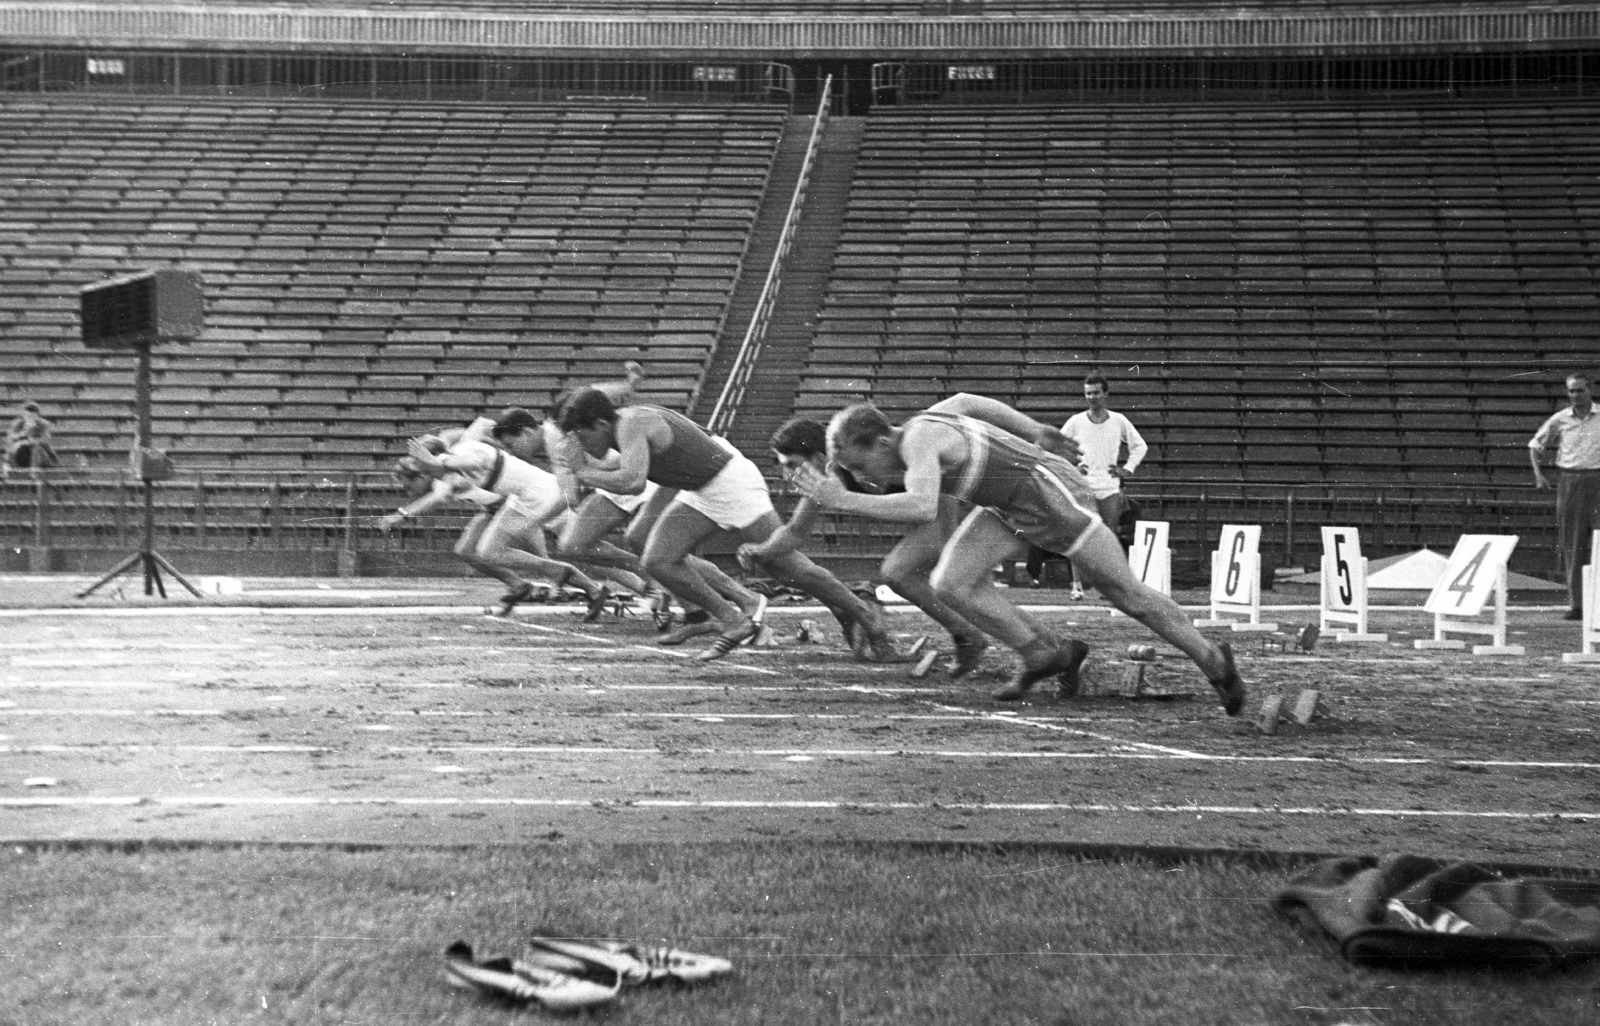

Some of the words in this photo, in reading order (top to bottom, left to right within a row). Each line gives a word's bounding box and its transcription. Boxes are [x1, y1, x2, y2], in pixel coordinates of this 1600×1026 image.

[1142, 527, 1157, 582] 7
[1225, 530, 1245, 596] 6
[1334, 534, 1352, 605] 5
[1448, 541, 1492, 607] 4
